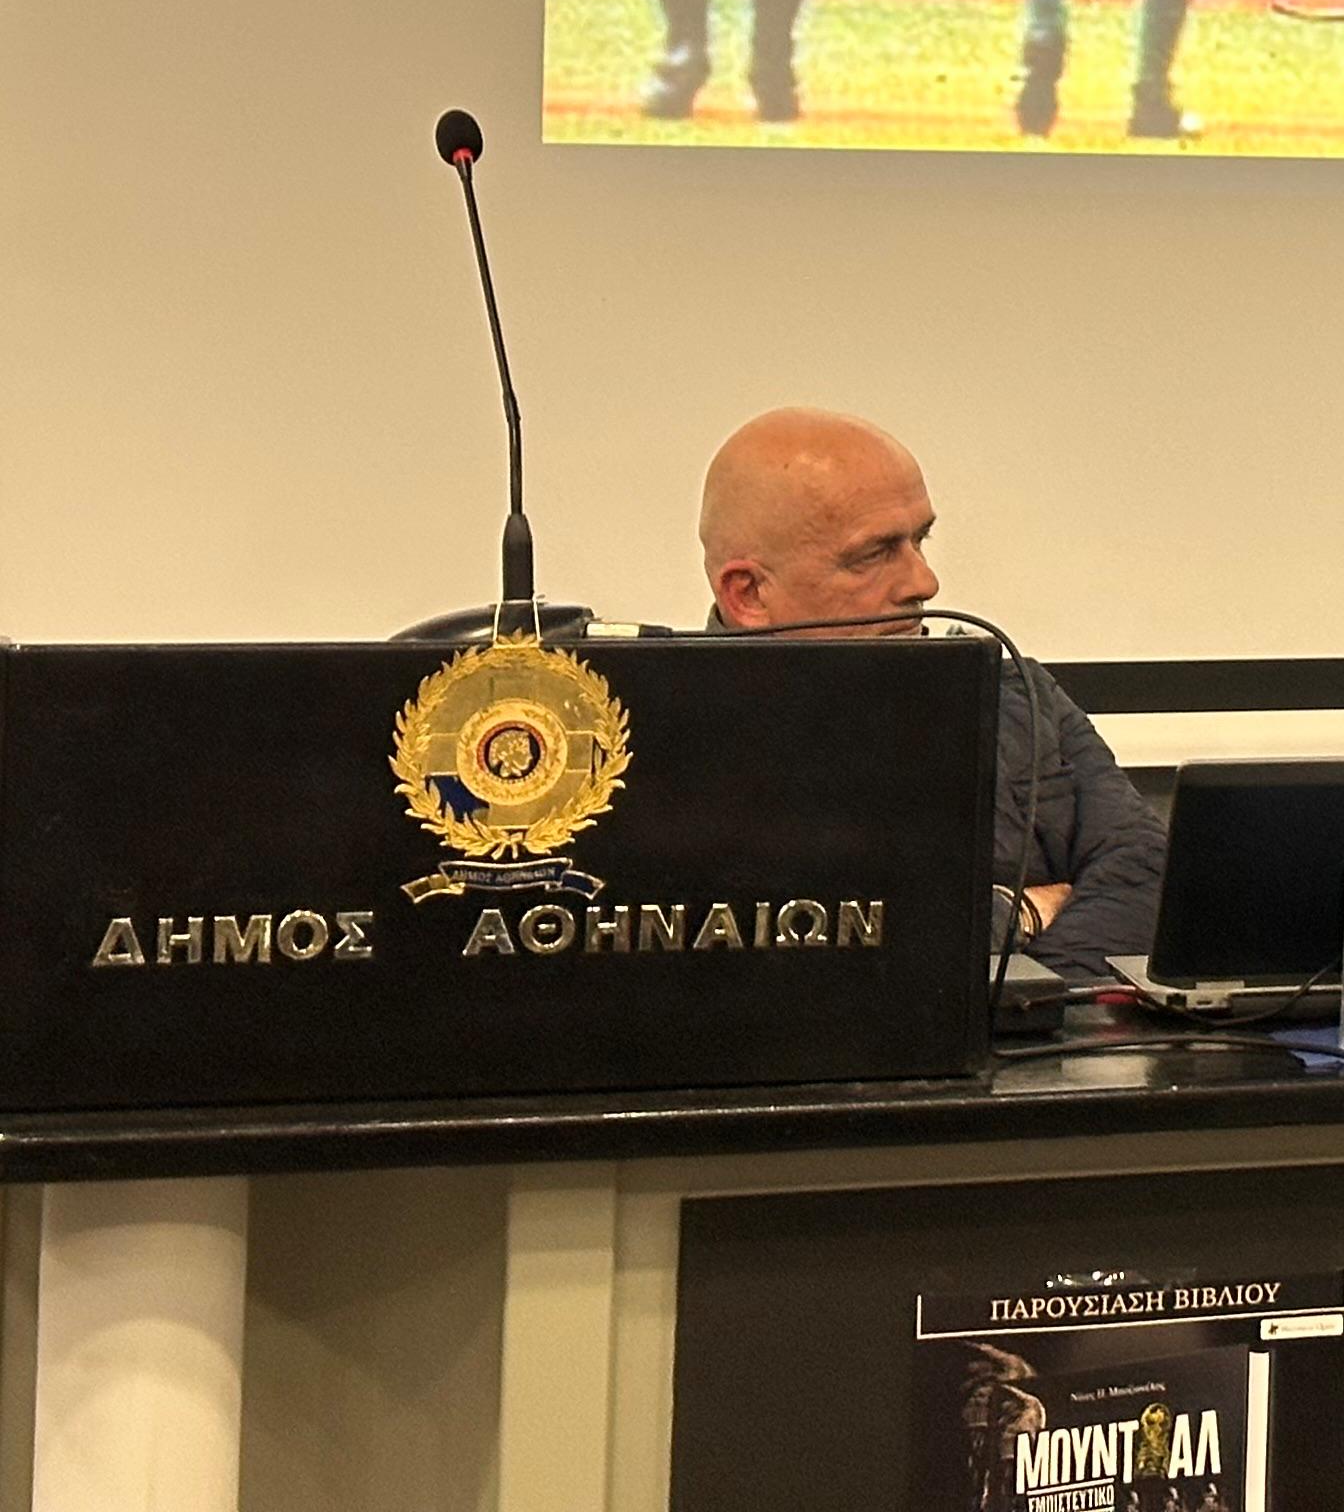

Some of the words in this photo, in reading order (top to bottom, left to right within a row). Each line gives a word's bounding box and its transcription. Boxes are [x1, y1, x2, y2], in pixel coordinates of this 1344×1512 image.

[92, 909, 376, 967] ΔΗΜΟΣ
[462, 898, 885, 956] ΑΘΗΝΑΙΩΝ
[990, 1287, 1165, 1321] ΠΑΡΟΥΣΙΑΣΗ
[1173, 1283, 1281, 1311] ΒΙΒΛΙΟΥ
